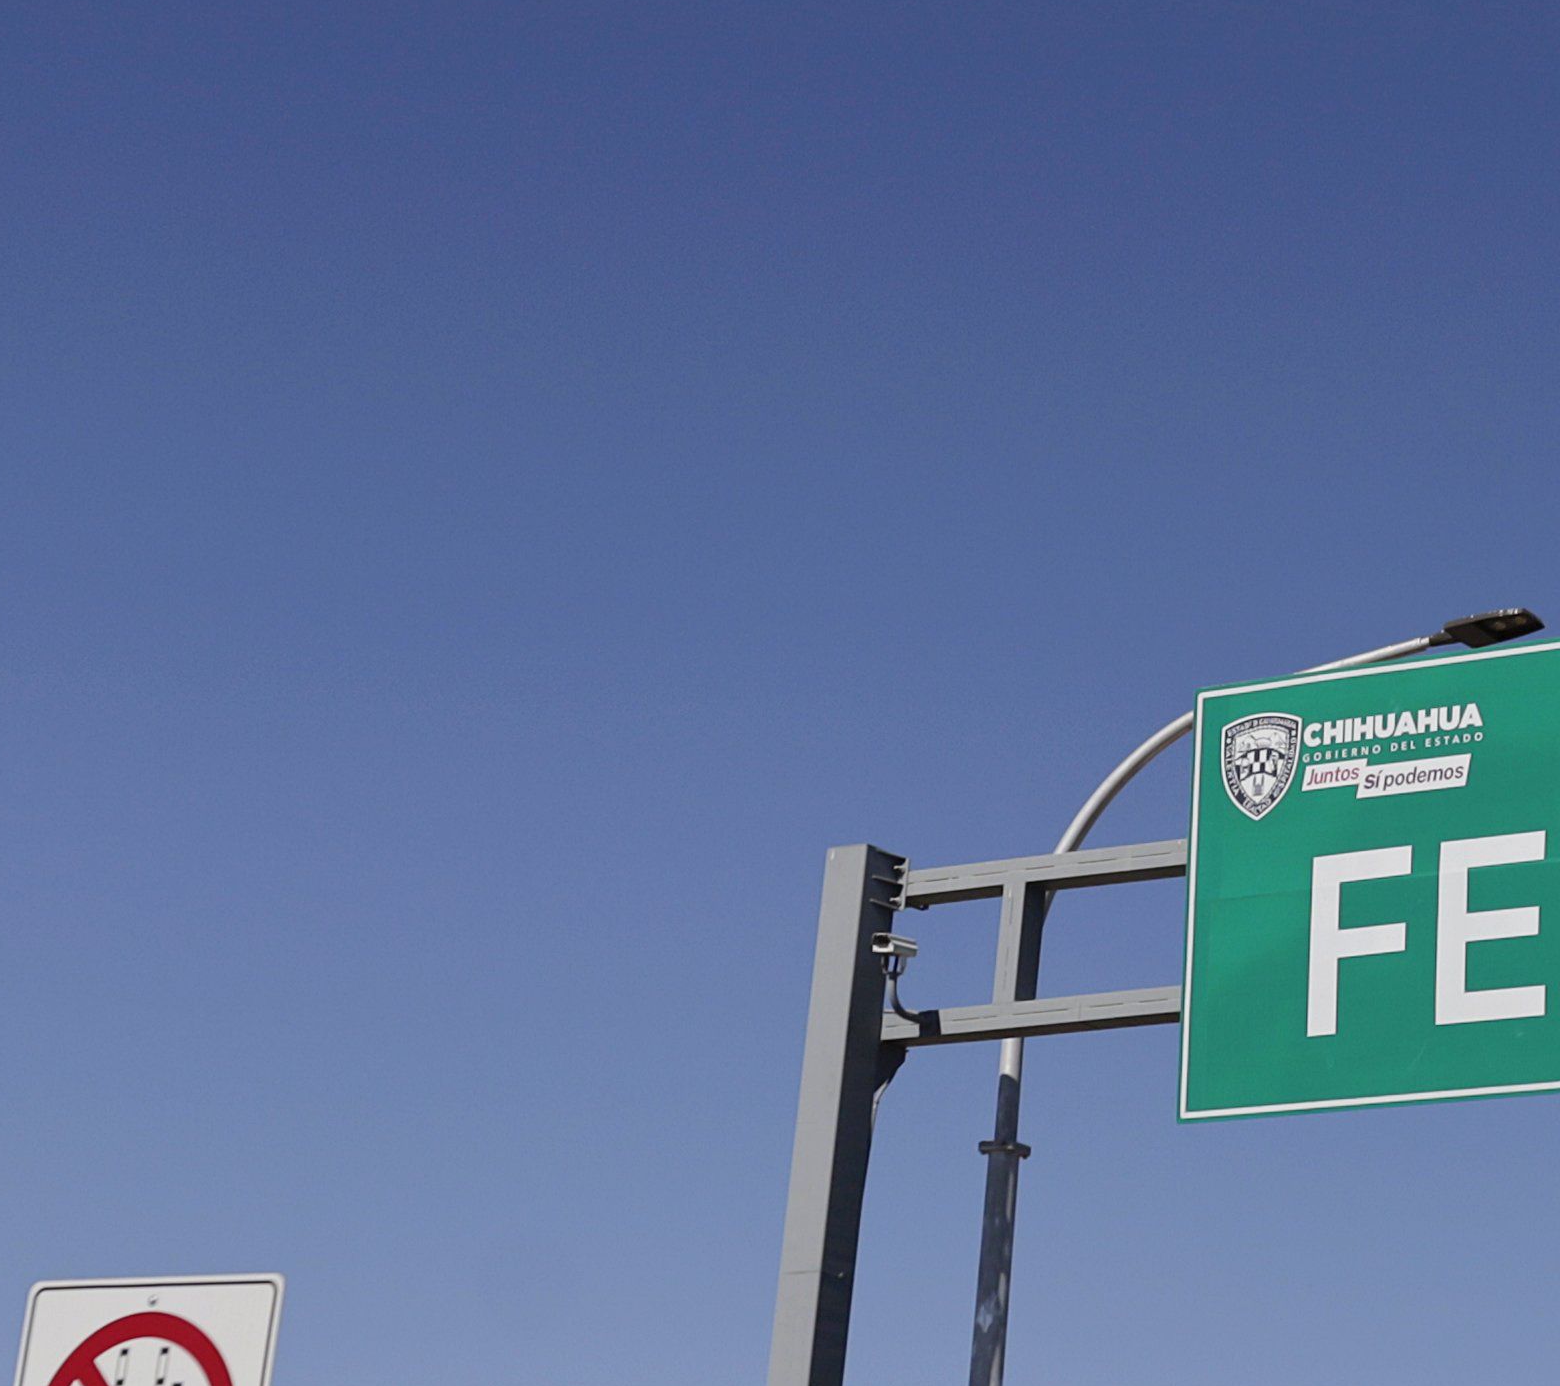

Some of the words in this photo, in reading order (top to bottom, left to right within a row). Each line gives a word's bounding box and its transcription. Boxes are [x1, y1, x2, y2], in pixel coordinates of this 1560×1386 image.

[1303, 702, 1484, 748] CHIHUAHUA
[1302, 743, 1382, 764] GOBIERNO
[1390, 740, 1417, 753] DEL
[1425, 731, 1484, 748] ESTADO
[1306, 764, 1360, 787] Juntos
[1383, 763, 1465, 791] podemos
